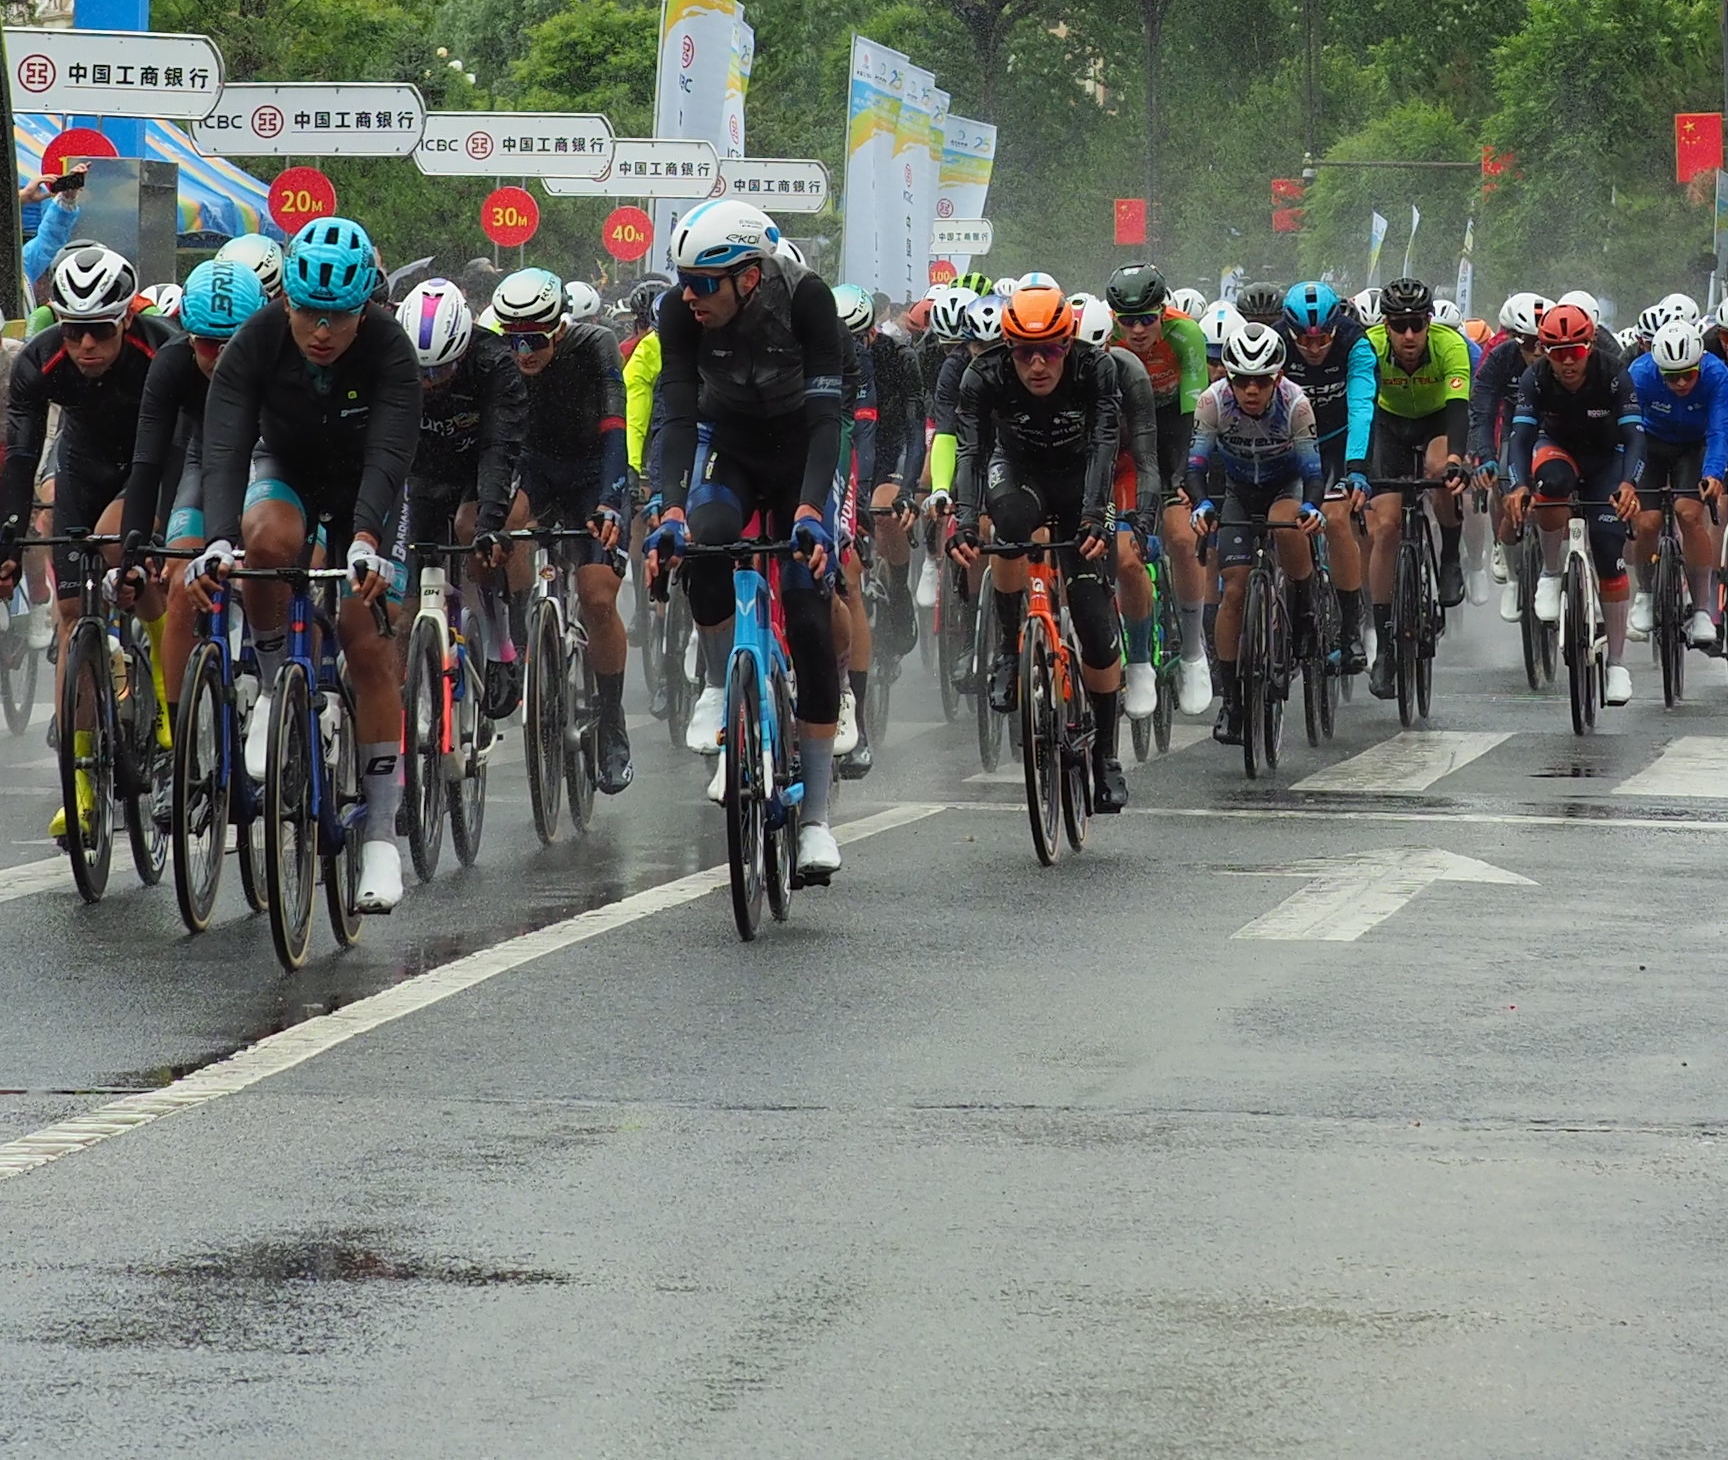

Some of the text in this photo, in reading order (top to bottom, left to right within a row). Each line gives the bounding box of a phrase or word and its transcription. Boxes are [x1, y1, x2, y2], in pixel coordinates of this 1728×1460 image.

[67, 62, 211, 91] 中国工商银行
[294, 111, 414, 130] 中国工商银行
[421, 139, 459, 152] ICBC
[502, 136, 605, 154] 中国工商银行
[619, 161, 710, 177] 中国工商银行
[733, 179, 821, 193] 中国工商银行
[280, 191, 323, 213] 20M
[492, 207, 528, 227] 30M
[612, 225, 645, 243] 40M
[938, 232, 988, 241] 中国工商银行
[392, 503, 409, 562] BARDIANI
